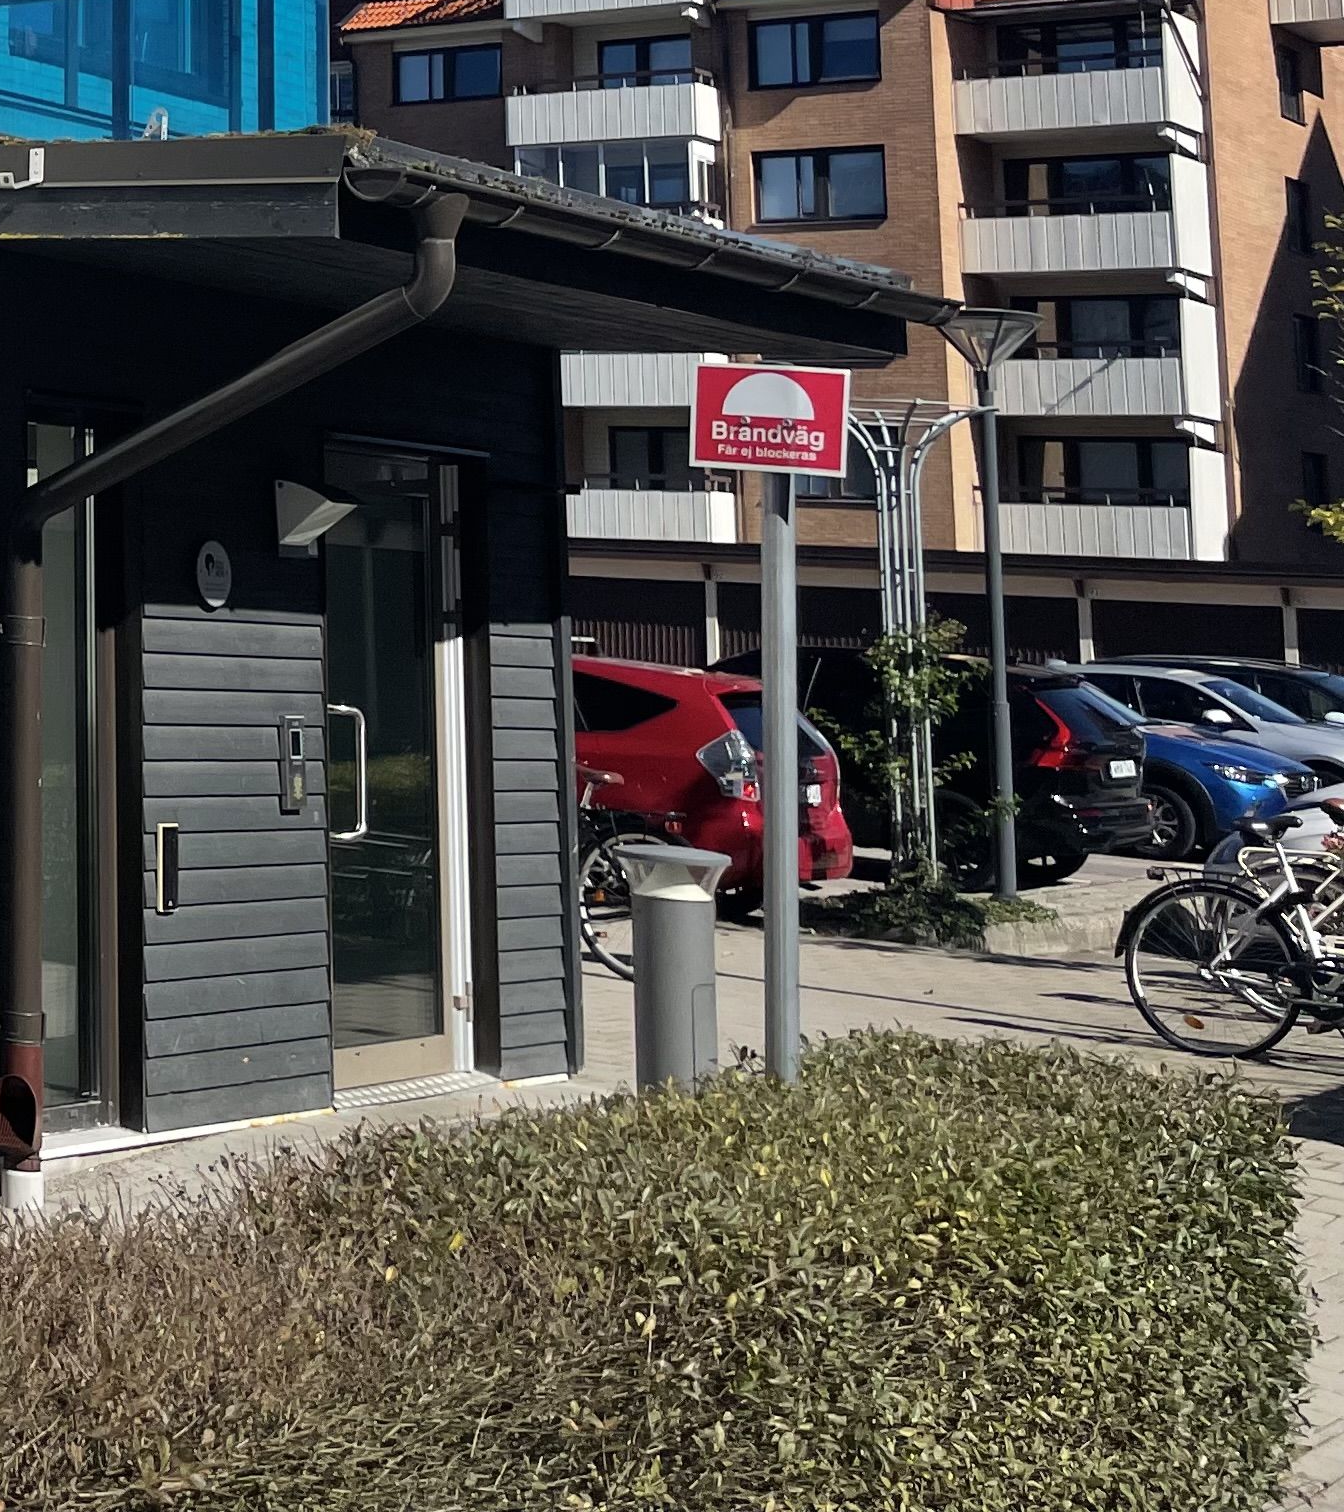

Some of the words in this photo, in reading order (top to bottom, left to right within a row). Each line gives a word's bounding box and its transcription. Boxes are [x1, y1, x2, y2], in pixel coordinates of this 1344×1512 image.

[712, 420, 824, 451] Brandväg
[717, 443, 737, 455] Får
[740, 445, 752, 459] ej
[755, 446, 816, 461] blockeras
